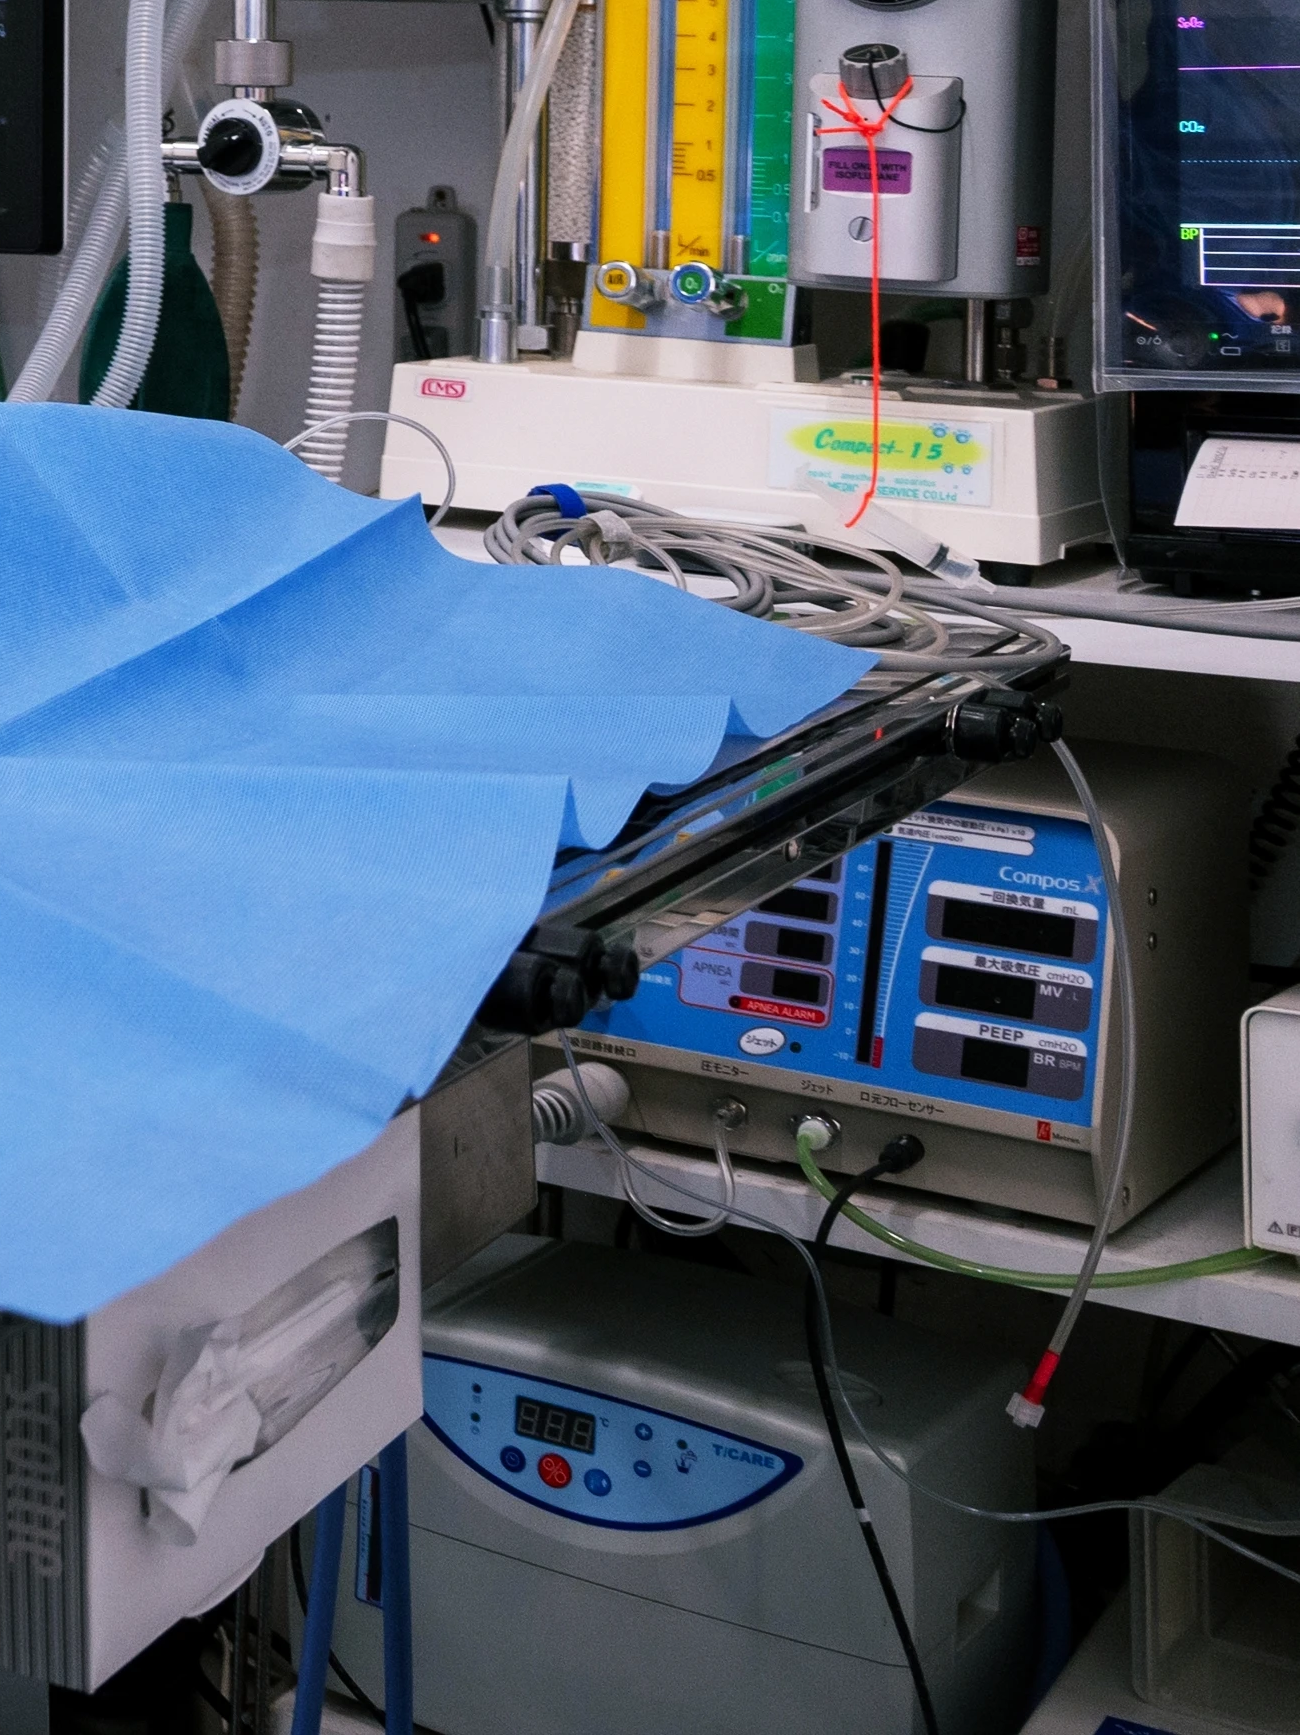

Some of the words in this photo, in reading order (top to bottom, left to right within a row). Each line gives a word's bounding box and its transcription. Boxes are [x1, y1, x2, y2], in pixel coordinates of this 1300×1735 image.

[1177, 16, 1205, 29] SpO2
[708, 32, 717, 42] 4
[707, 64, 716, 76] 3
[783, 72, 793, 85] 3
[706, 100, 715, 112] 2
[258, 116, 274, 137] AUTO
[1179, 121, 1205, 133] CO2
[827, 161, 850, 170] FILL
[881, 163, 907, 172] WITH
[696, 169, 717, 182] 0.5
[834, 170, 901, 181] ISOFLUANE
[1180, 228, 1199, 240] BP
[424, 380, 463, 397] CMS
[877, 486, 920, 499] SERVICE
[979, 891, 1045, 910] 一回換気量
[1062, 904, 1079, 916] mL
[692, 962, 733, 979] APNEA
[974, 955, 1041, 977] 最大吸気圧
[1046, 970, 1086, 985] cmH2O
[1039, 983, 1063, 998] MV
[747, 1001, 780, 1015] APNEA
[781, 1007, 816, 1022] ALARM
[745, 1034, 777, 1049] ジェット
[979, 1024, 1024, 1042] PEEP
[1039, 1037, 1078, 1053] cmH2O
[701, 1061, 749, 1078] 圧モニター
[1033, 1052, 1056, 1067] BR
[1059, 1058, 1081, 1072] BPM
[801, 1079, 833, 1095] ジェット
[860, 1091, 944, 1114] 口元フローセンサー
